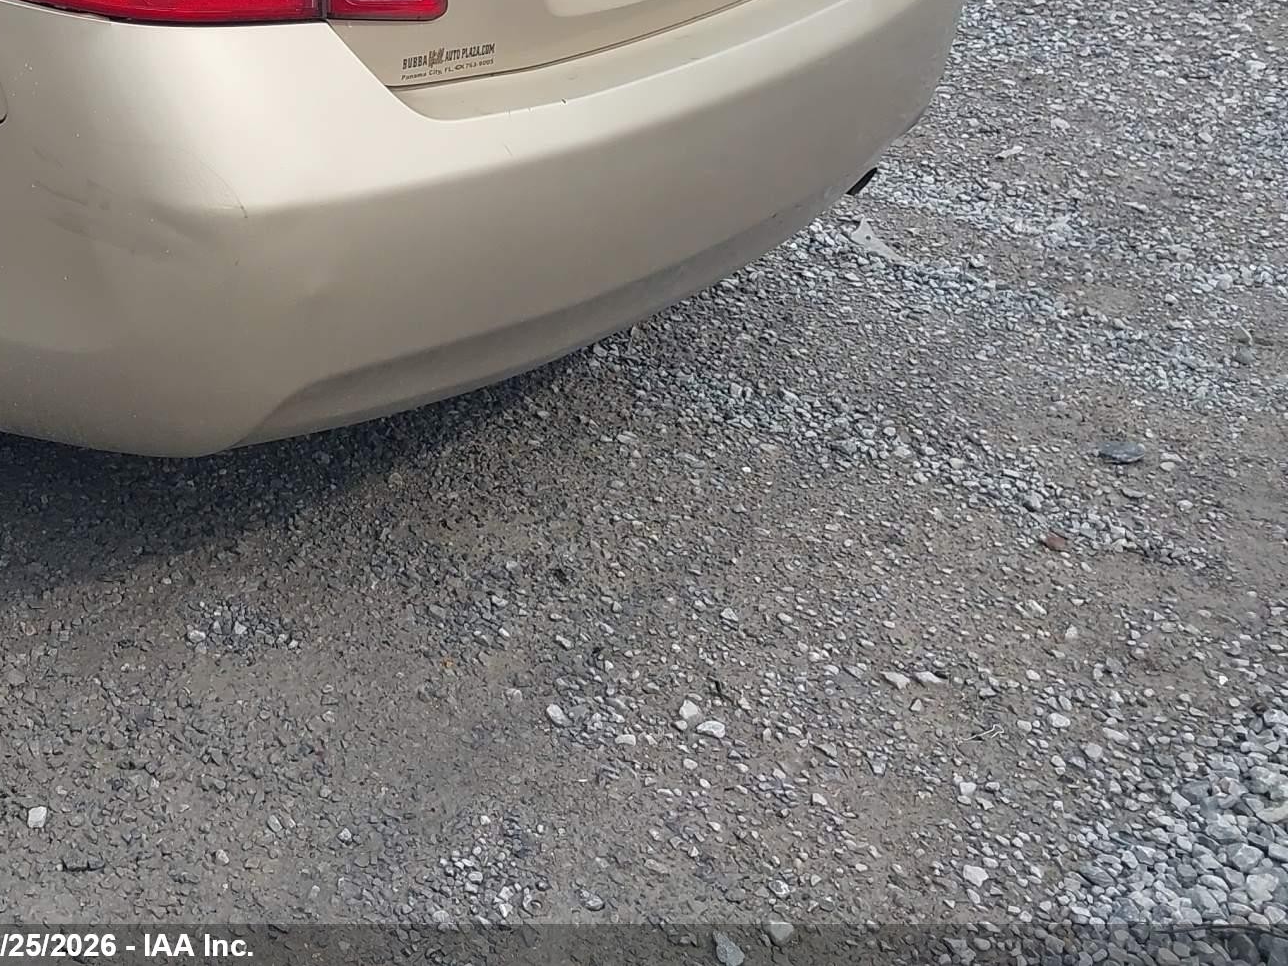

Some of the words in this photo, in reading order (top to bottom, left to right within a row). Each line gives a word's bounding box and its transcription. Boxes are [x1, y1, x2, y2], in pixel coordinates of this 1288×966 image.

[402, 54, 428, 70] BUBBA
[444, 50, 461, 63] AUTO
[461, 43, 495, 59] PLAZA.COM
[401, 71, 427, 81] Panama
